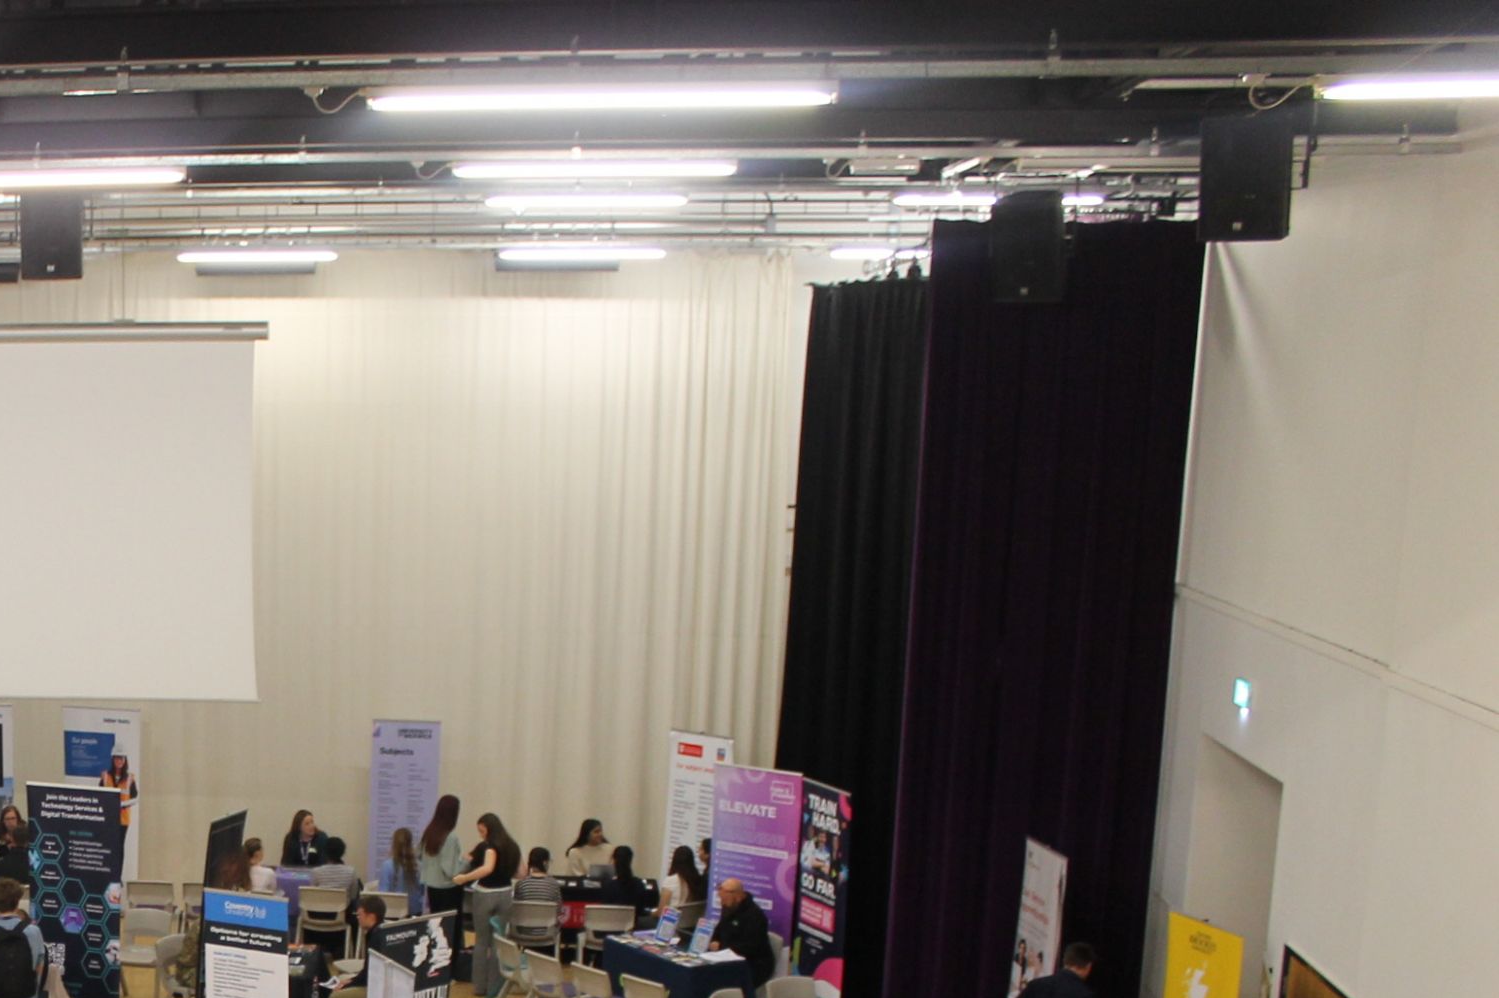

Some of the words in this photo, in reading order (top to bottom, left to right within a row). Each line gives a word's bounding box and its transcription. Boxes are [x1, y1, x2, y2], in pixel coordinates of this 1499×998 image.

[379, 746, 414, 757] Subjects
[69, 794, 92, 803] Leaders
[808, 793, 838, 817] TRAIN
[41, 801, 74, 811] Technology
[74, 804, 98, 813] Services
[718, 799, 777, 819] ELEVATE
[41, 810, 61, 819] Digital
[61, 812, 106, 822] Transformation
[801, 872, 815, 892] GO
[210, 926, 238, 936] Options
[238, 929, 250, 937] for
[250, 932, 283, 944] creating
[226, 935, 249, 944] better
[249, 938, 273, 948] future
